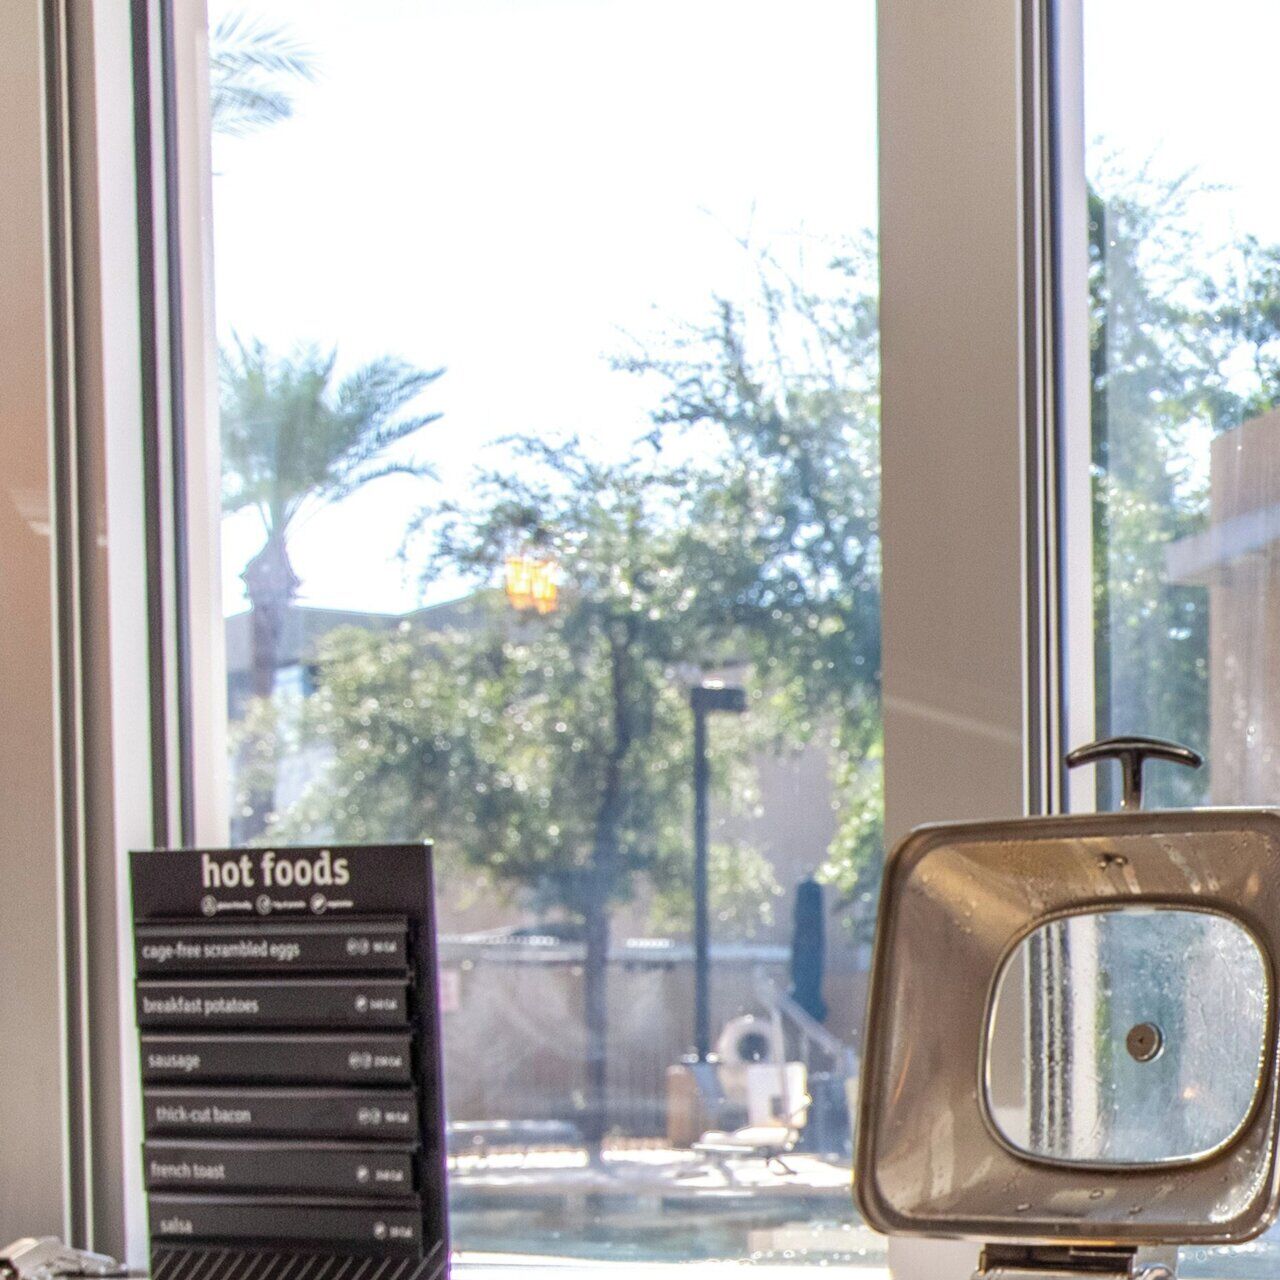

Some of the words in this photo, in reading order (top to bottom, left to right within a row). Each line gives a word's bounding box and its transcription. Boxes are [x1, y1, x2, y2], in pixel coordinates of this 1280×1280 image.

[202, 853, 254, 888] hot
[261, 850, 350, 887] foods
[269, 943, 300, 961] eggs
[204, 997, 259, 1016] potatoes
[149, 1055, 200, 1071] sausage
[213, 1107, 251, 1123] bacon
[151, 1163, 191, 1178] french
[193, 1163, 225, 1180] toast
[160, 1217, 193, 1234] salsa
